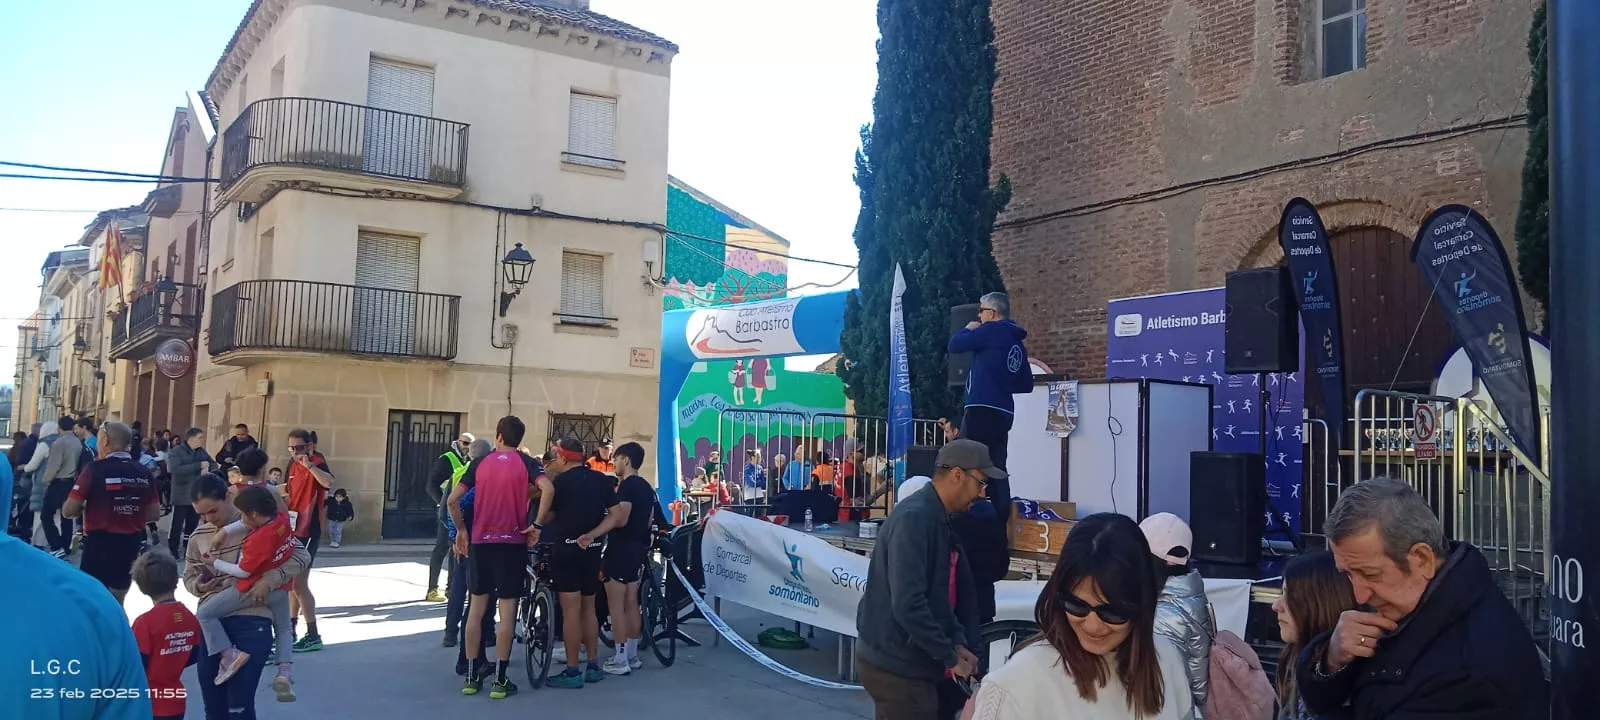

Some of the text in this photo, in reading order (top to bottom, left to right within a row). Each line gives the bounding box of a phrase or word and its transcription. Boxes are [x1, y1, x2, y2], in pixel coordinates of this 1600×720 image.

[735, 317, 790, 334] Barbastro
[1146, 312, 1198, 330] Atletismo
[160, 353, 190, 363] AMBAR
[1037, 521, 1049, 552] 3
[716, 545, 752, 566] Comarcal
[703, 561, 749, 584] de Deportes
[768, 583, 820, 609] somontano
